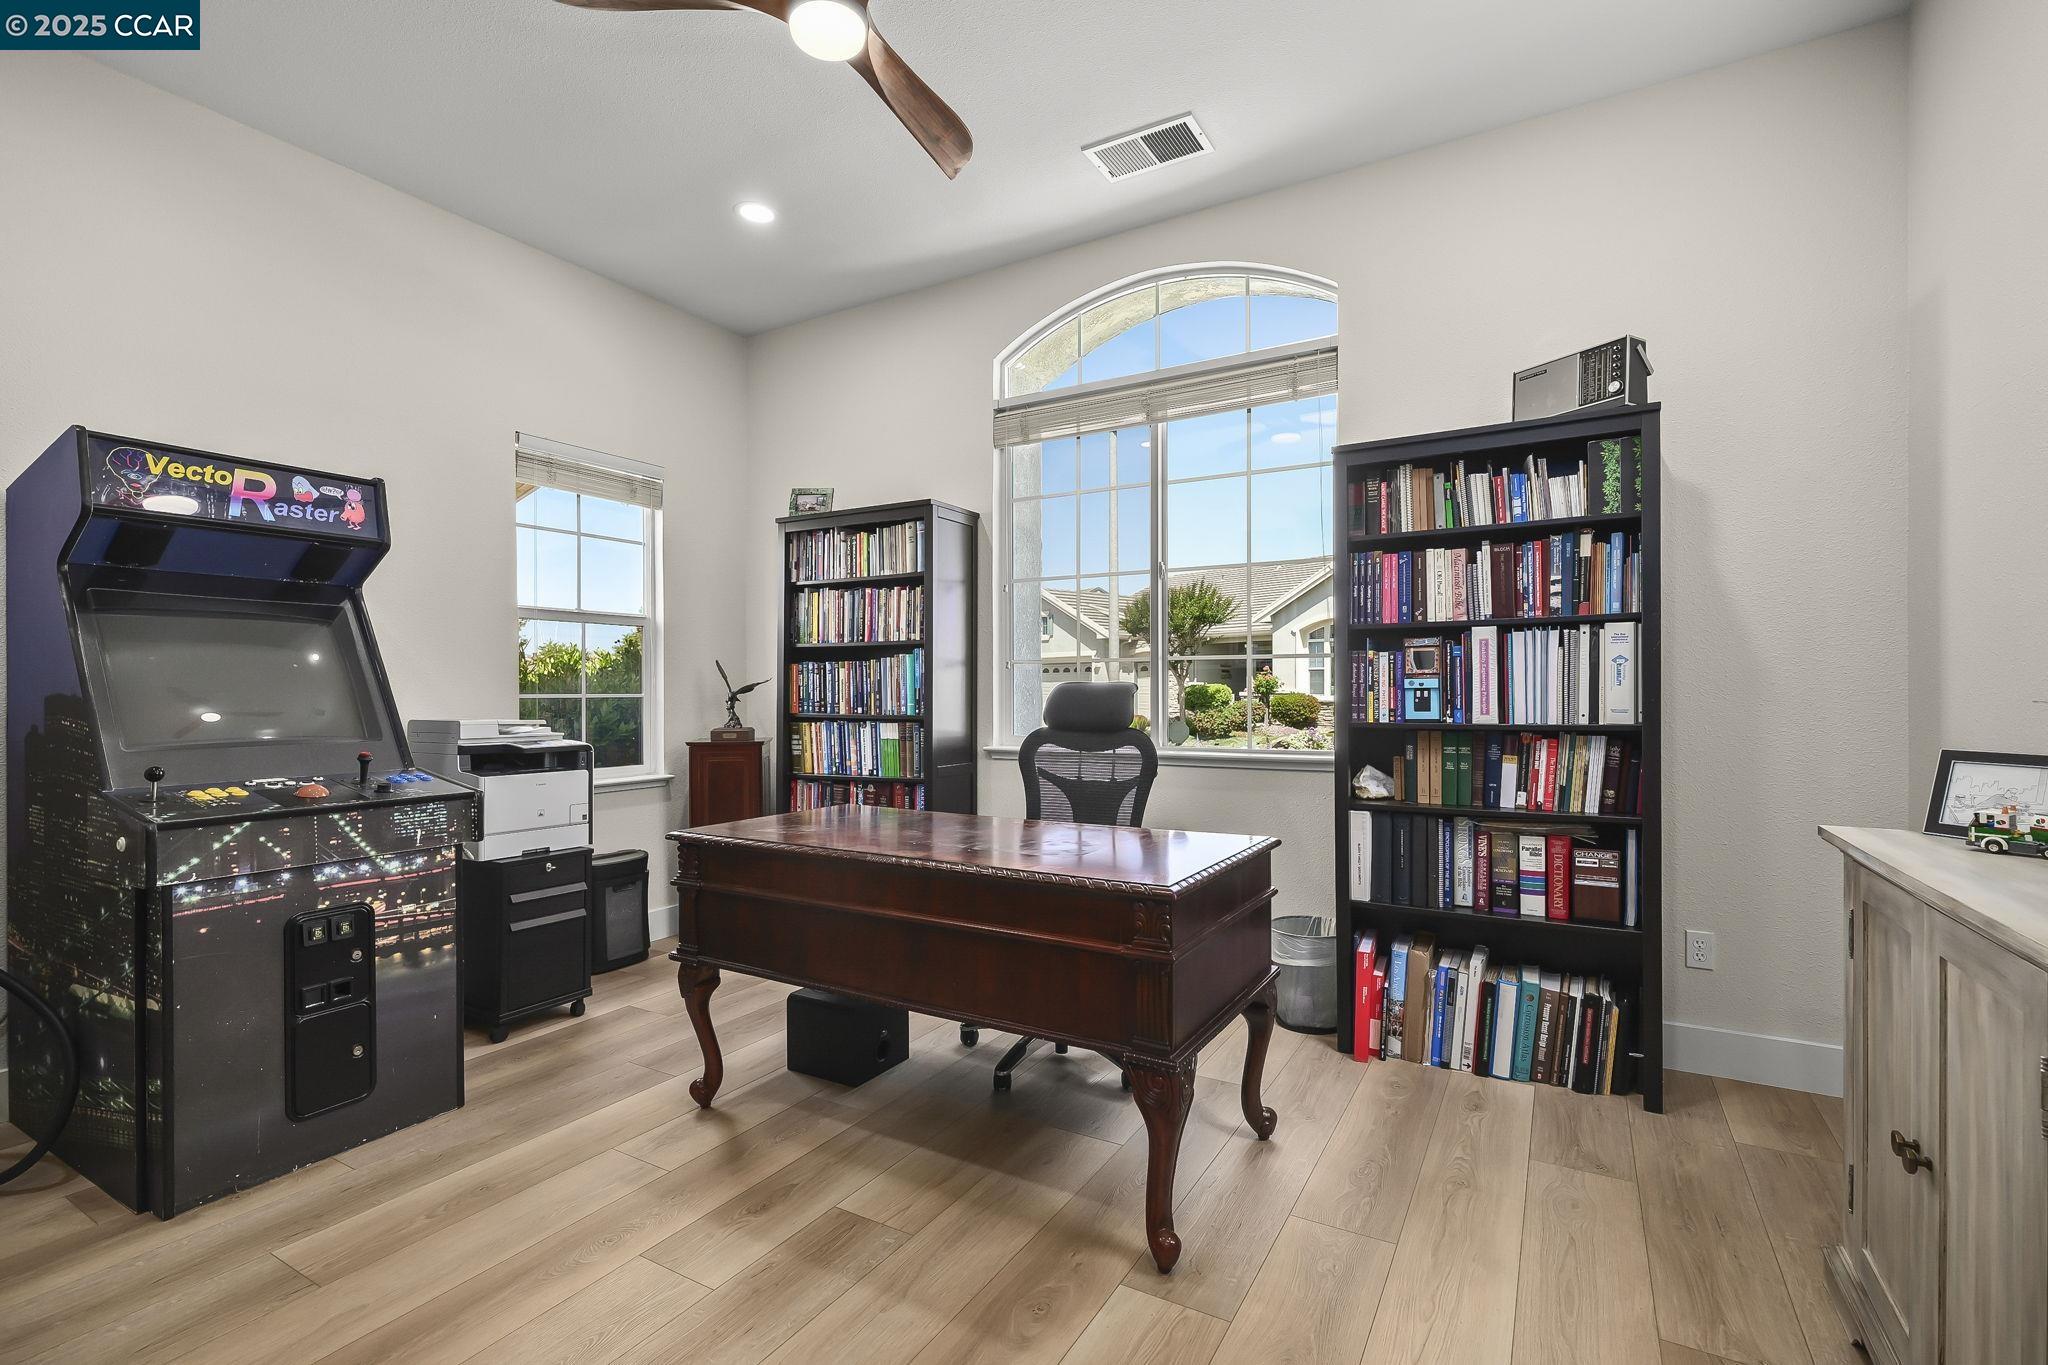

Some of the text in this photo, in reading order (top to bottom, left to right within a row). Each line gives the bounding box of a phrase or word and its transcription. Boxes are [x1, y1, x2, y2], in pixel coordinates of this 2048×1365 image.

[1454, 553, 1463, 610] Macintosh Bible
[1478, 835, 1487, 857] VINE'S
[1554, 853, 1564, 909] DICTIONARY
[1394, 961, 1402, 974] Los
[1542, 1003, 1551, 1021] Pressure
[1521, 1004, 1534, 1062] Corrosion Atlas
[1541, 1021, 1549, 1034] Vessel
[1539, 1034, 1548, 1047] Design
